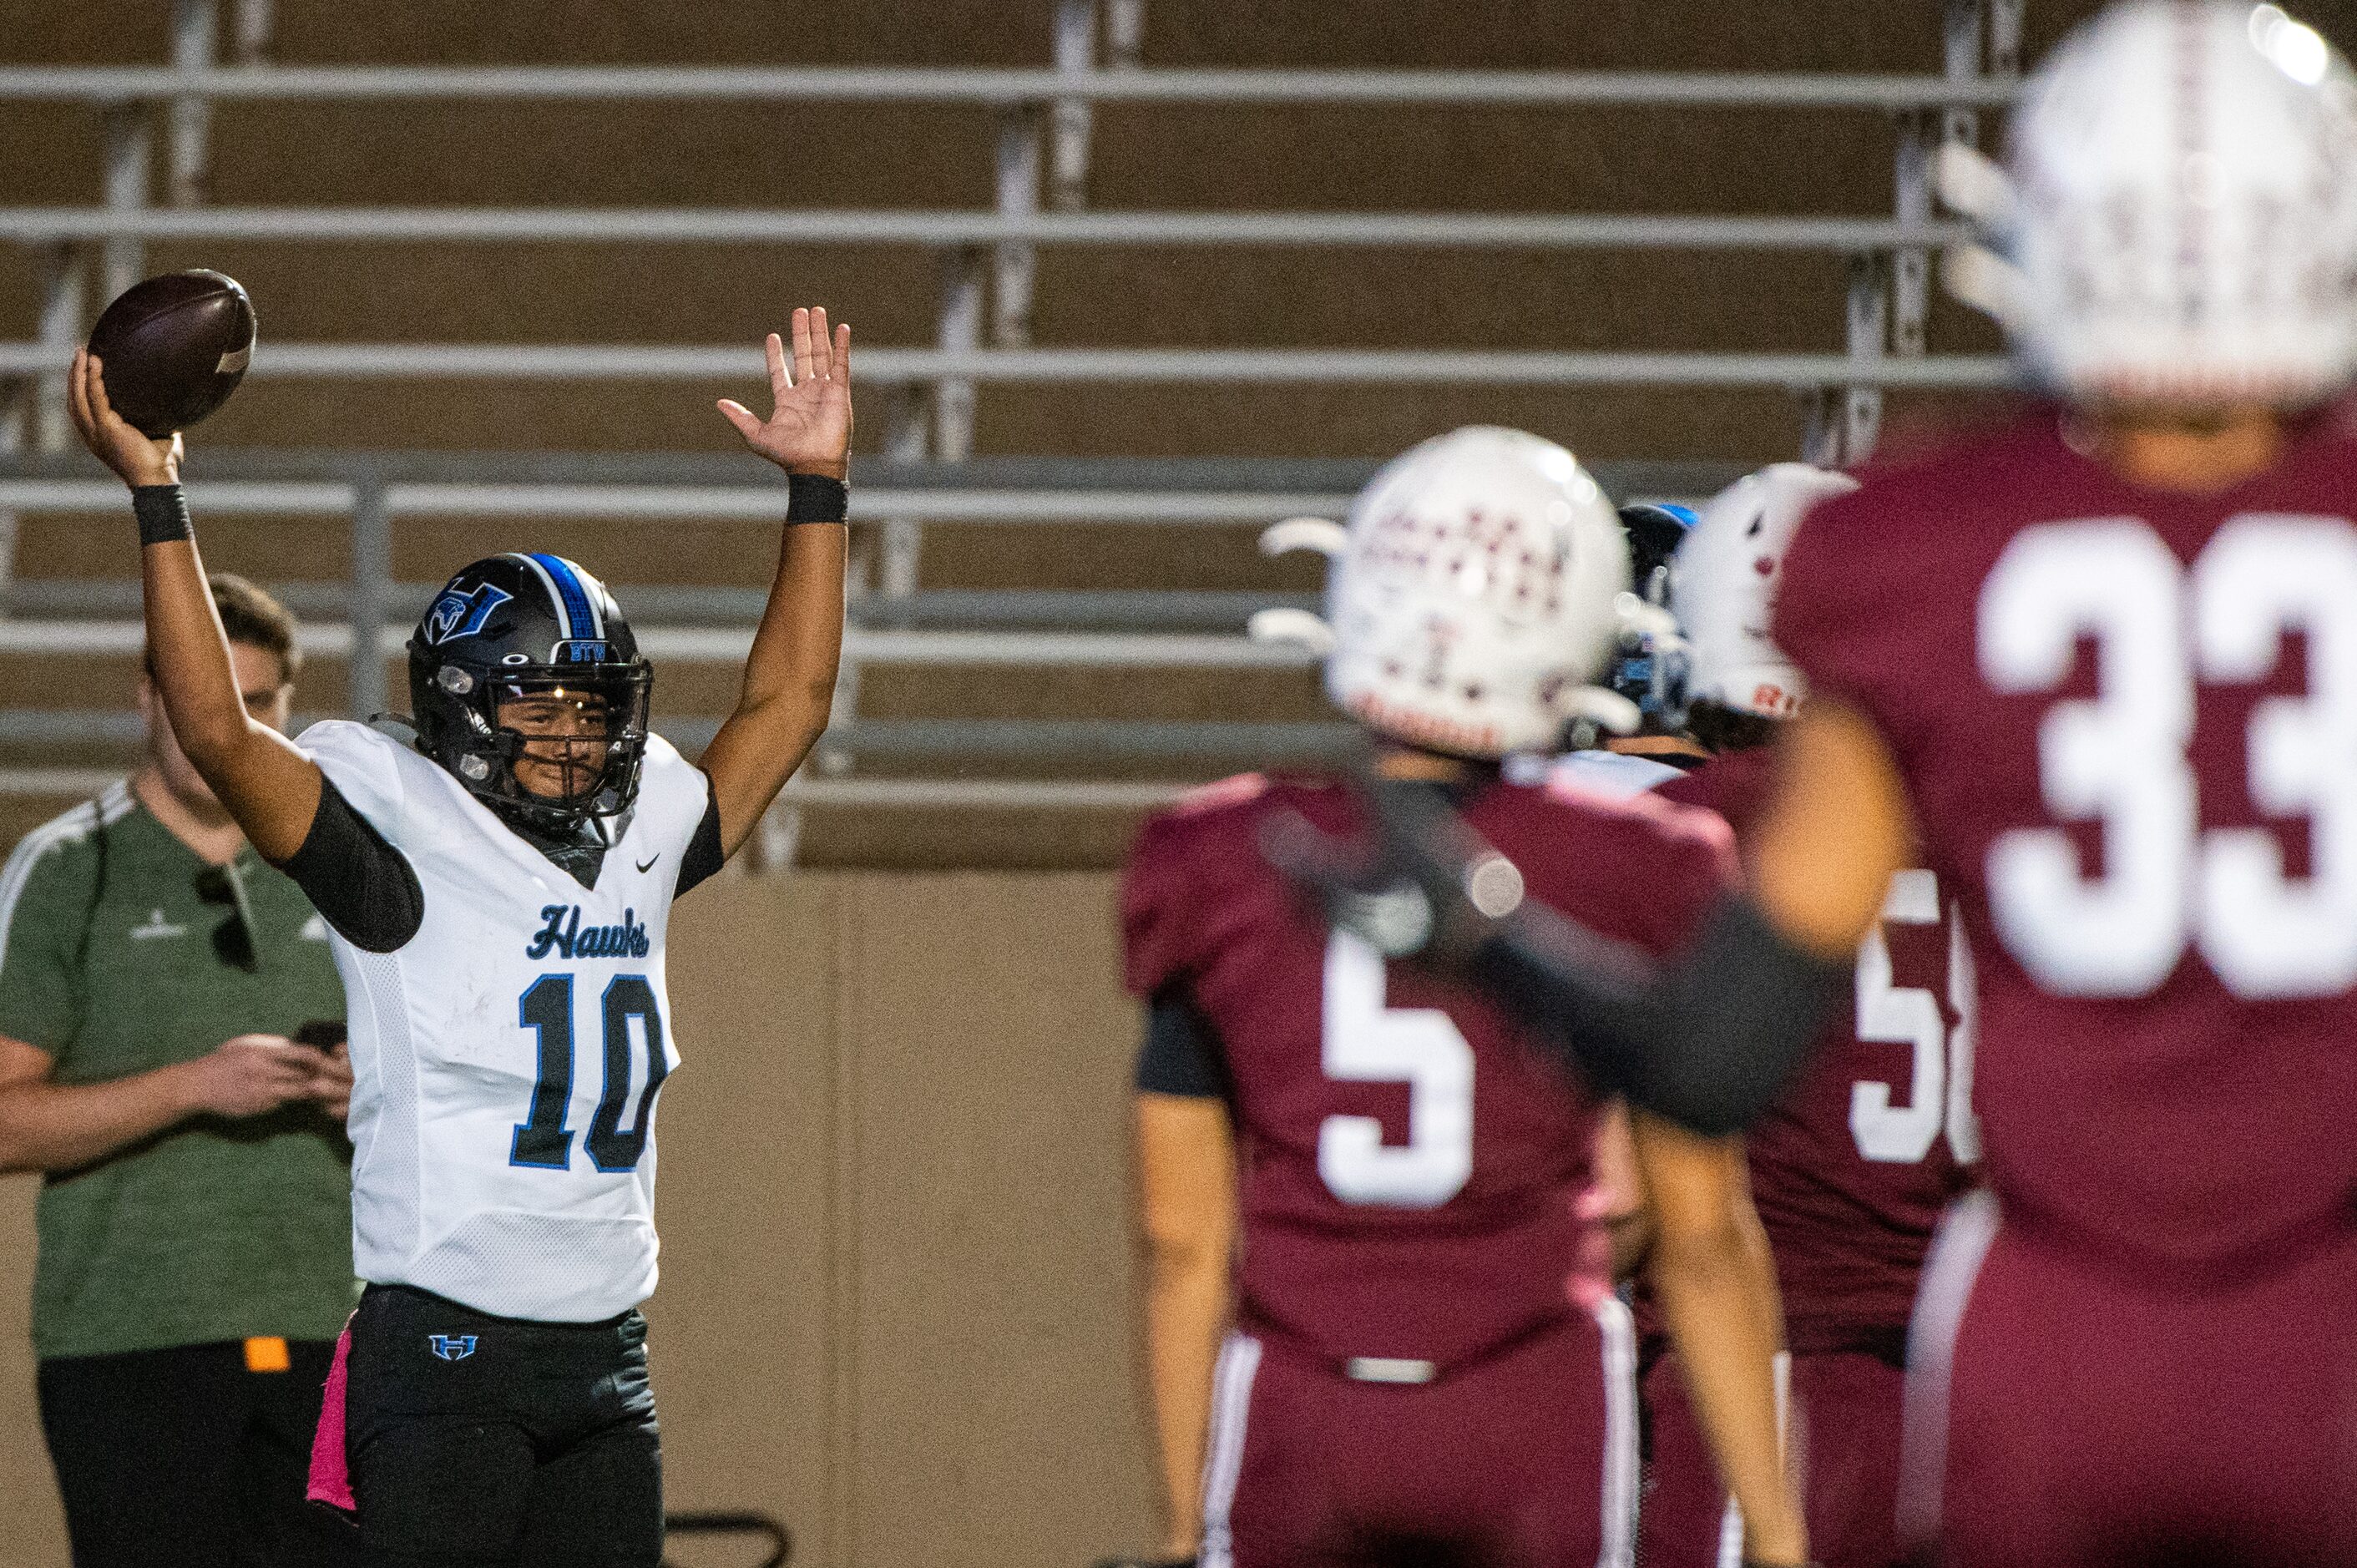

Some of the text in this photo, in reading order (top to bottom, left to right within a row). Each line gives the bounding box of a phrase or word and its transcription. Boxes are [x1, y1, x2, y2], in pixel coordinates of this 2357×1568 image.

[569, 642, 605, 662] BTW
[1975, 513, 2357, 999] 33
[526, 904, 650, 959] Hawks
[508, 973, 669, 1173] 10
[1318, 925, 1476, 1208] 5
